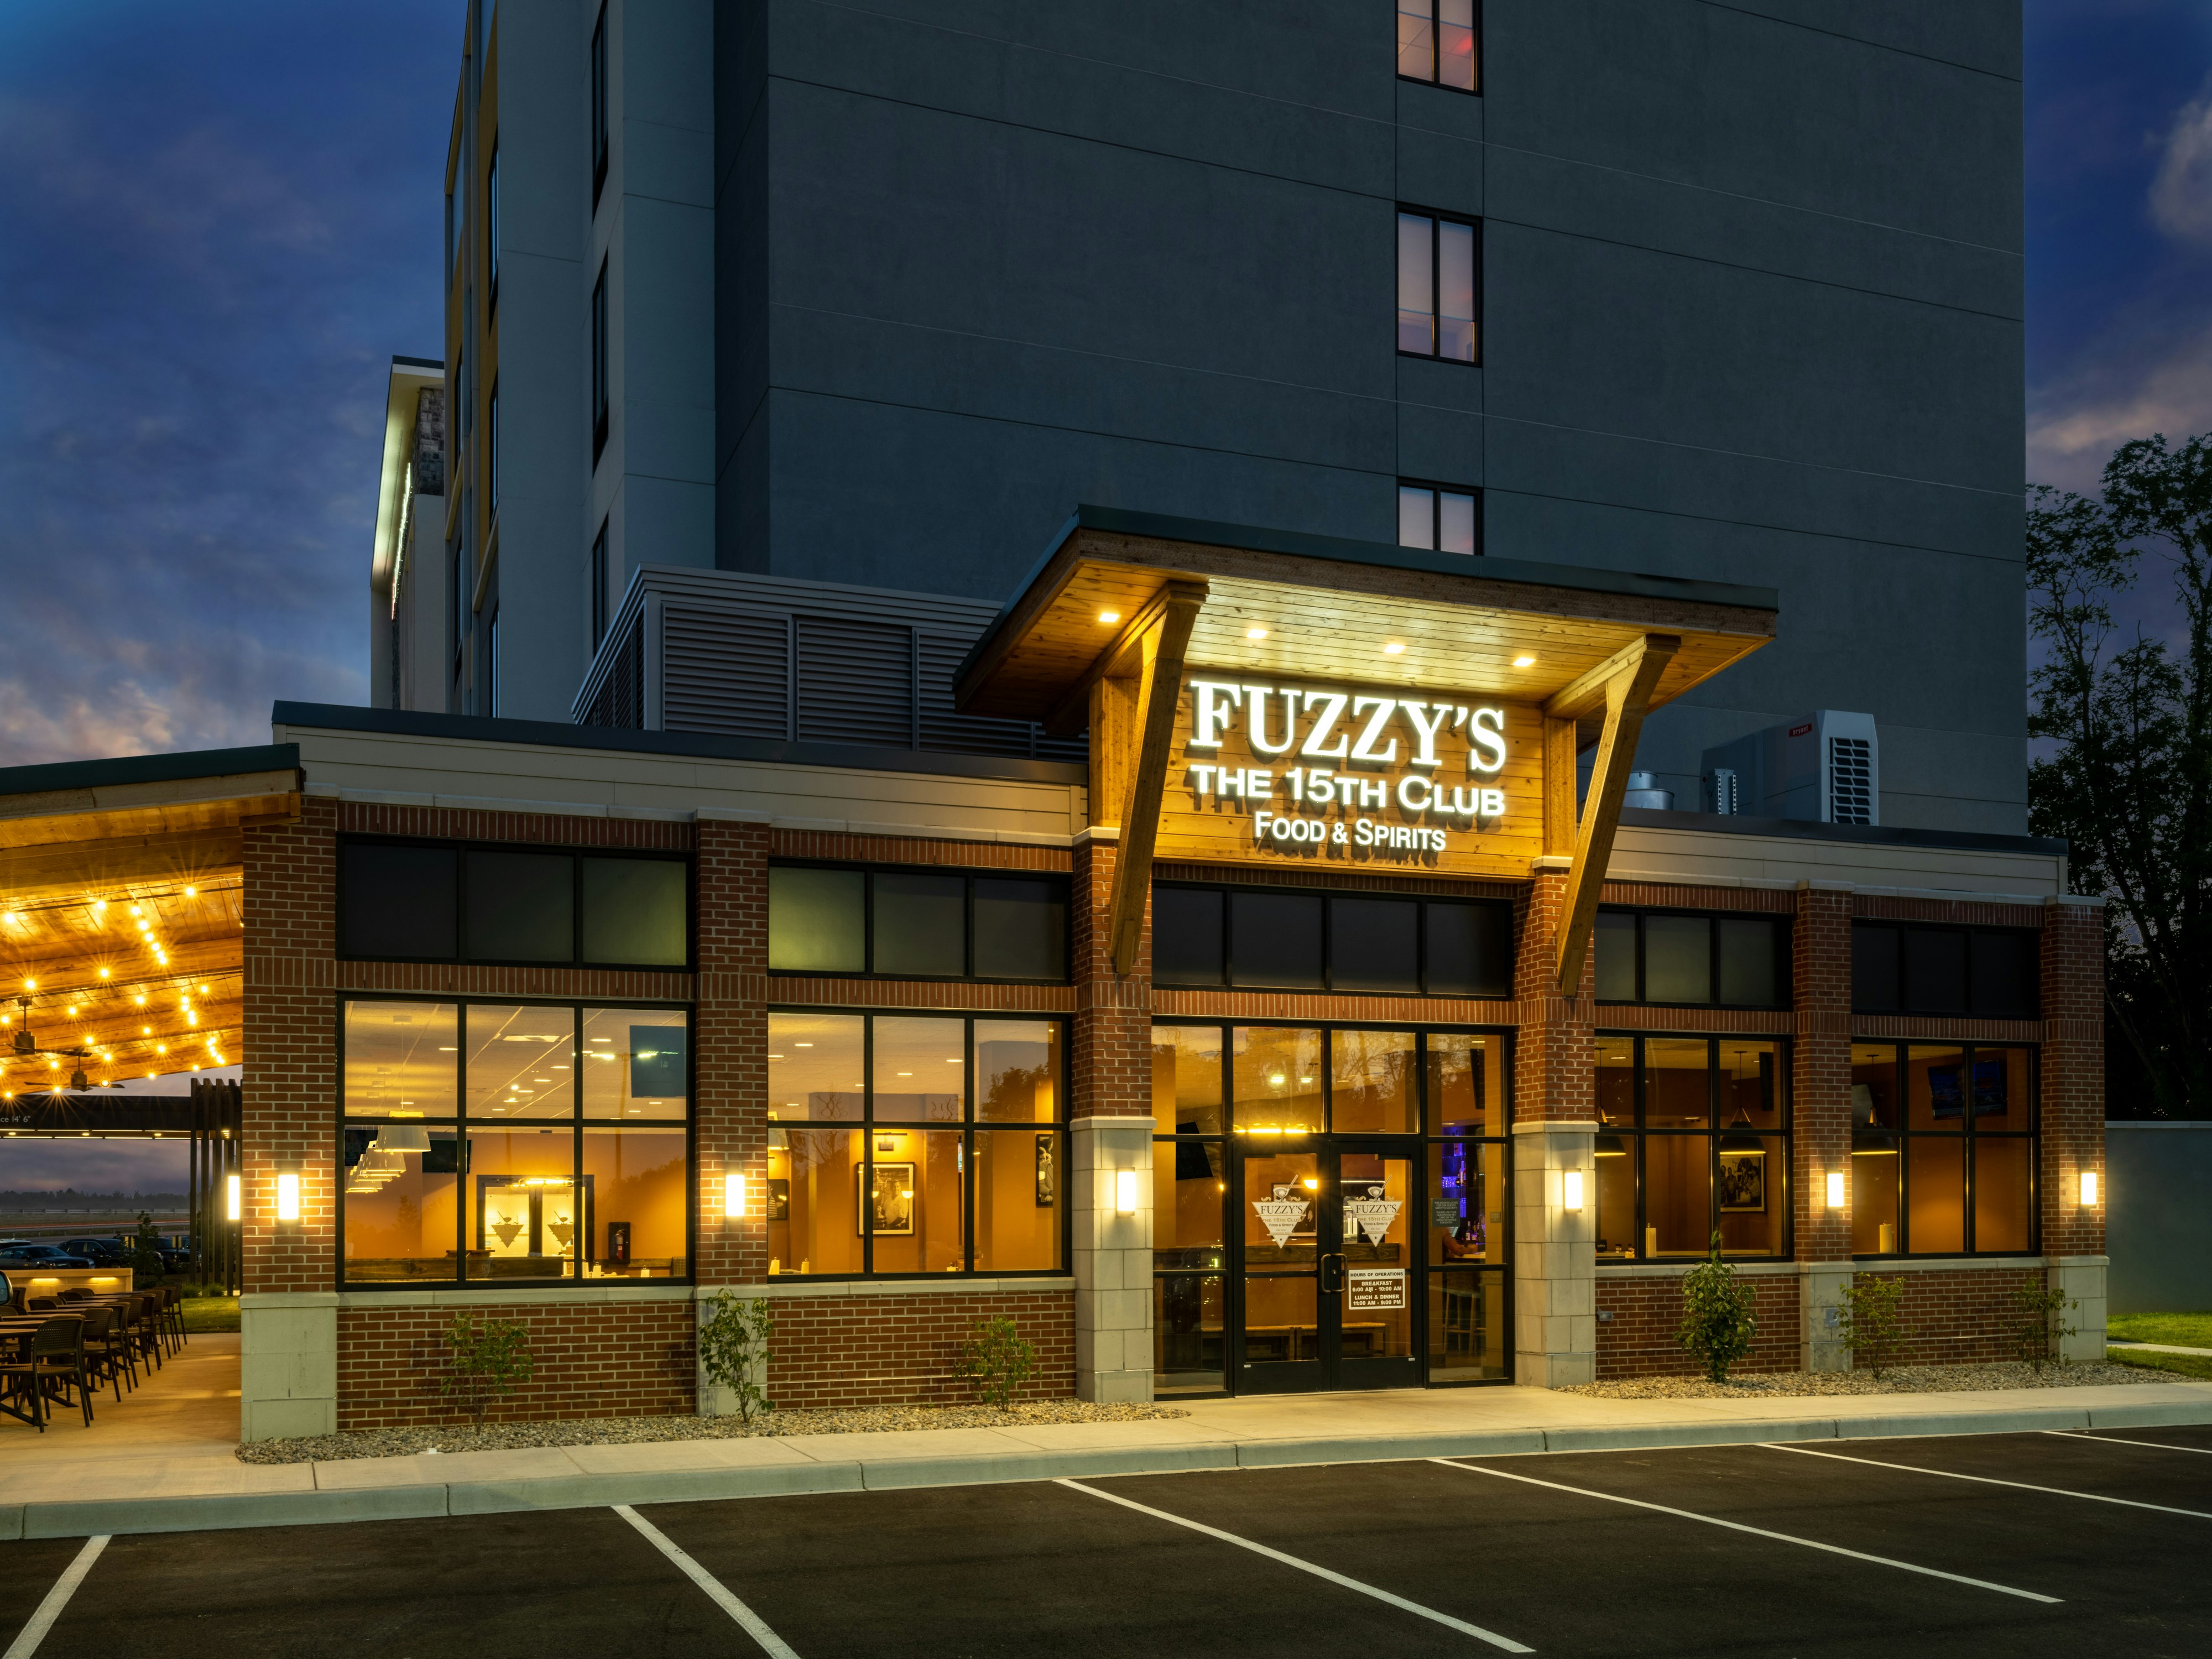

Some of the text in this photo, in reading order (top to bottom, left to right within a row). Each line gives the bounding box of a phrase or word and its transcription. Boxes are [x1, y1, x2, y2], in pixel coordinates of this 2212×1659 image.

[1190, 680, 1506, 772] FUZZY'S
[1793, 726, 1808, 735] bryant
[1190, 764, 1505, 816] THE 15TH CLUB
[1255, 811, 1446, 851] FOOD & SPIRITS
[1260, 1205, 1303, 1214] FUZZY'S
[1355, 1204, 1396, 1213] FUZZY'S
